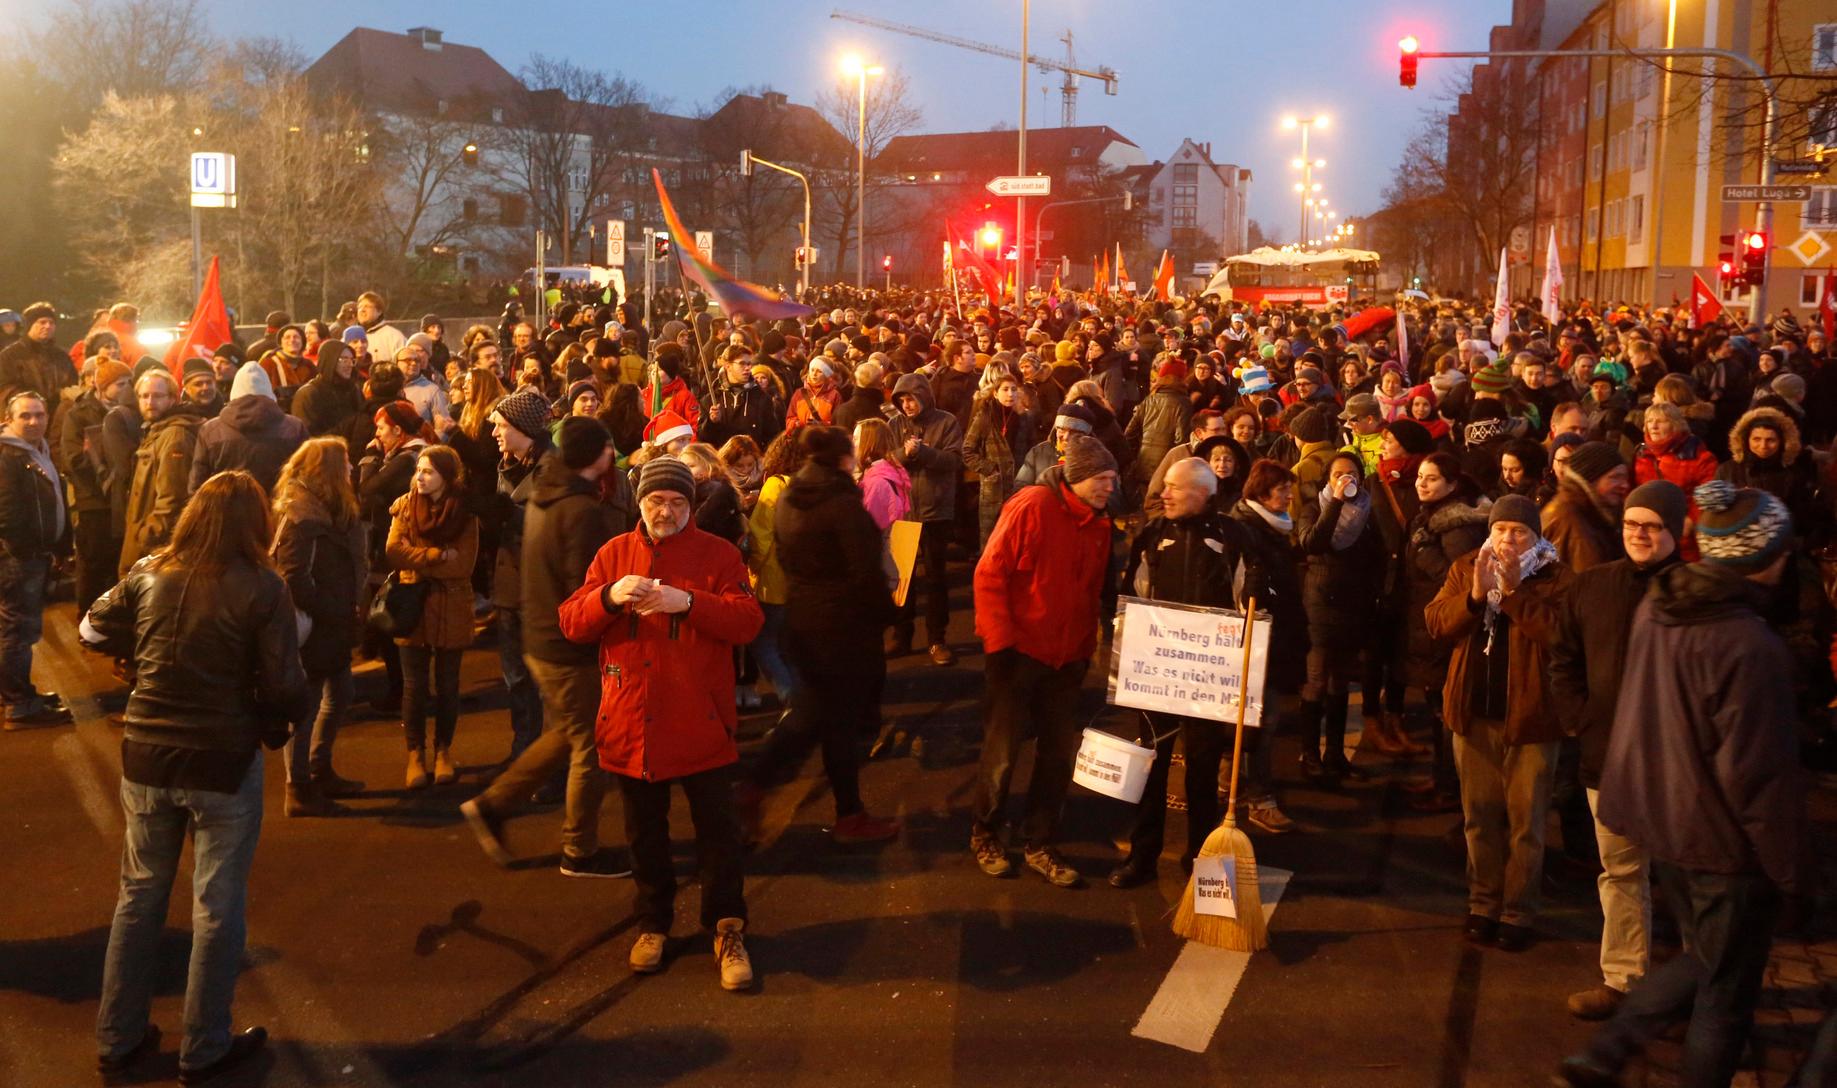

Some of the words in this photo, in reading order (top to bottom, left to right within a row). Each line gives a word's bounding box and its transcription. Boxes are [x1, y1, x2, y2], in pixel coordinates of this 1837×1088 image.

[197, 158, 215, 187] U
[1727, 188, 1758, 198] Hotel
[1148, 623, 1211, 648] Nürnberg
[1154, 646, 1230, 667] zusammen.
[1133, 659, 1159, 676] Was
[1163, 666, 1178, 678] es
[1182, 668, 1216, 684] nicht
[1220, 674, 1241, 688] wil
[1124, 677, 1170, 697] kommt
[1174, 685, 1186, 700] in
[1191, 688, 1216, 703] den
[1198, 876, 1224, 889] Nürnberg
